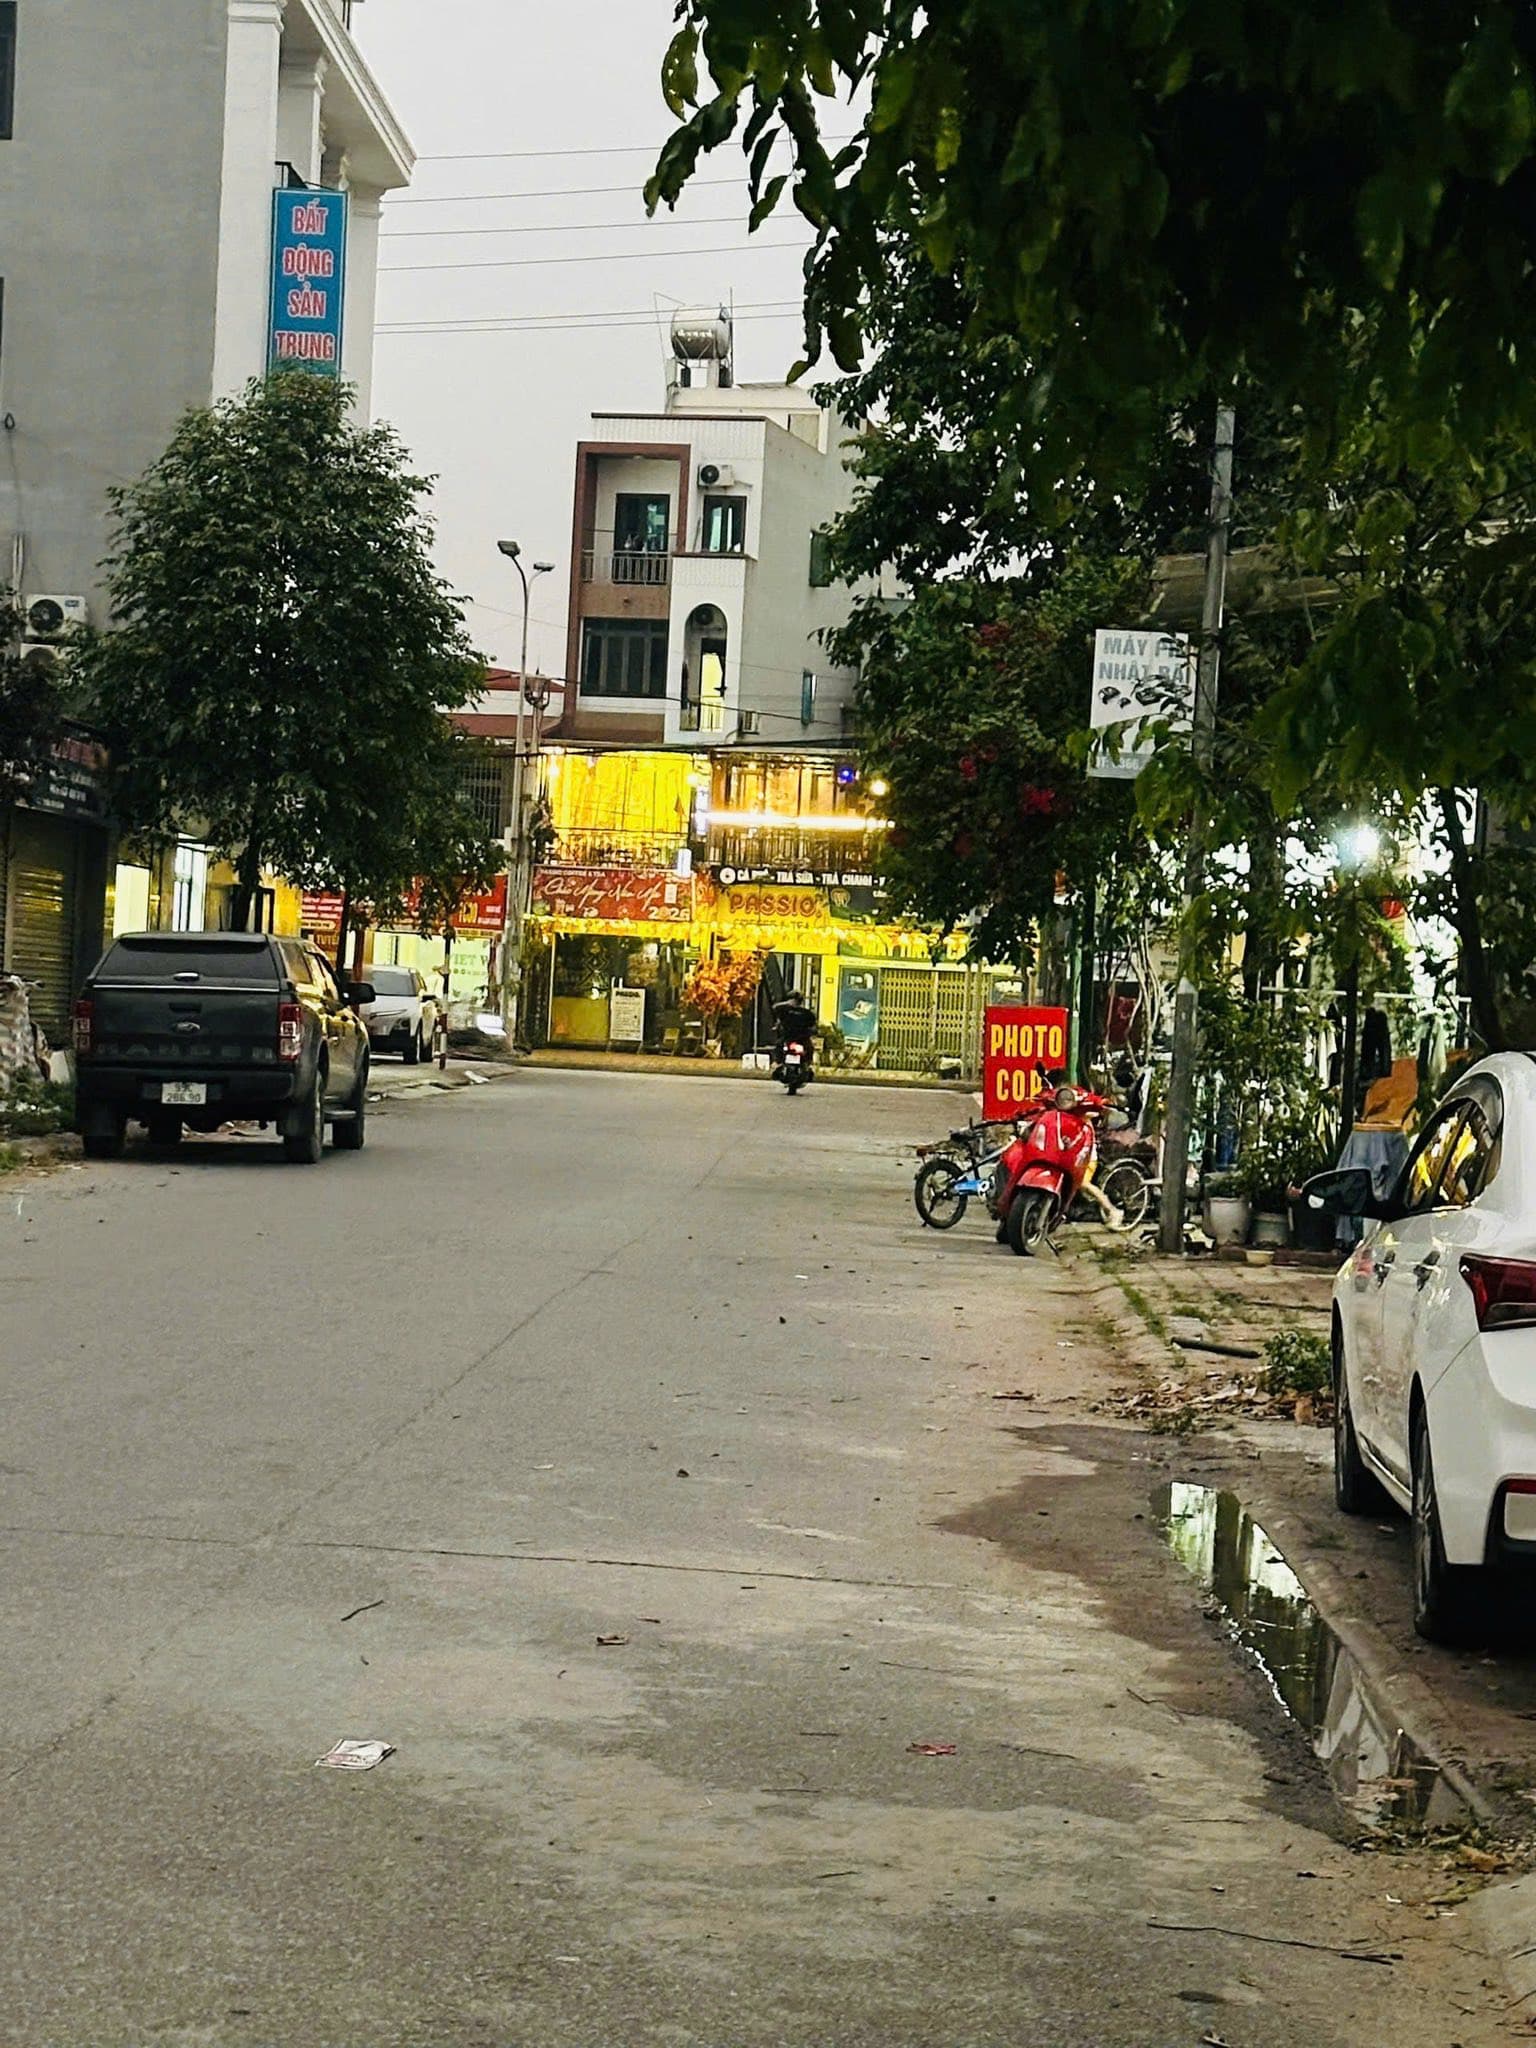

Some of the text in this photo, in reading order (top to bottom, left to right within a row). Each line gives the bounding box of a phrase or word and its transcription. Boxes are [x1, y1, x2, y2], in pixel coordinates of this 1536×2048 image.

[292, 198, 329, 236] BẤT
[283, 242, 334, 281] ĐỘNG
[287, 281, 327, 319] SẢN
[275, 330, 335, 361] TRUNG
[1103, 635, 1148, 656] MÁY
[991, 1024, 1062, 1058] PHOTO
[996, 1068, 1043, 1103] COP
